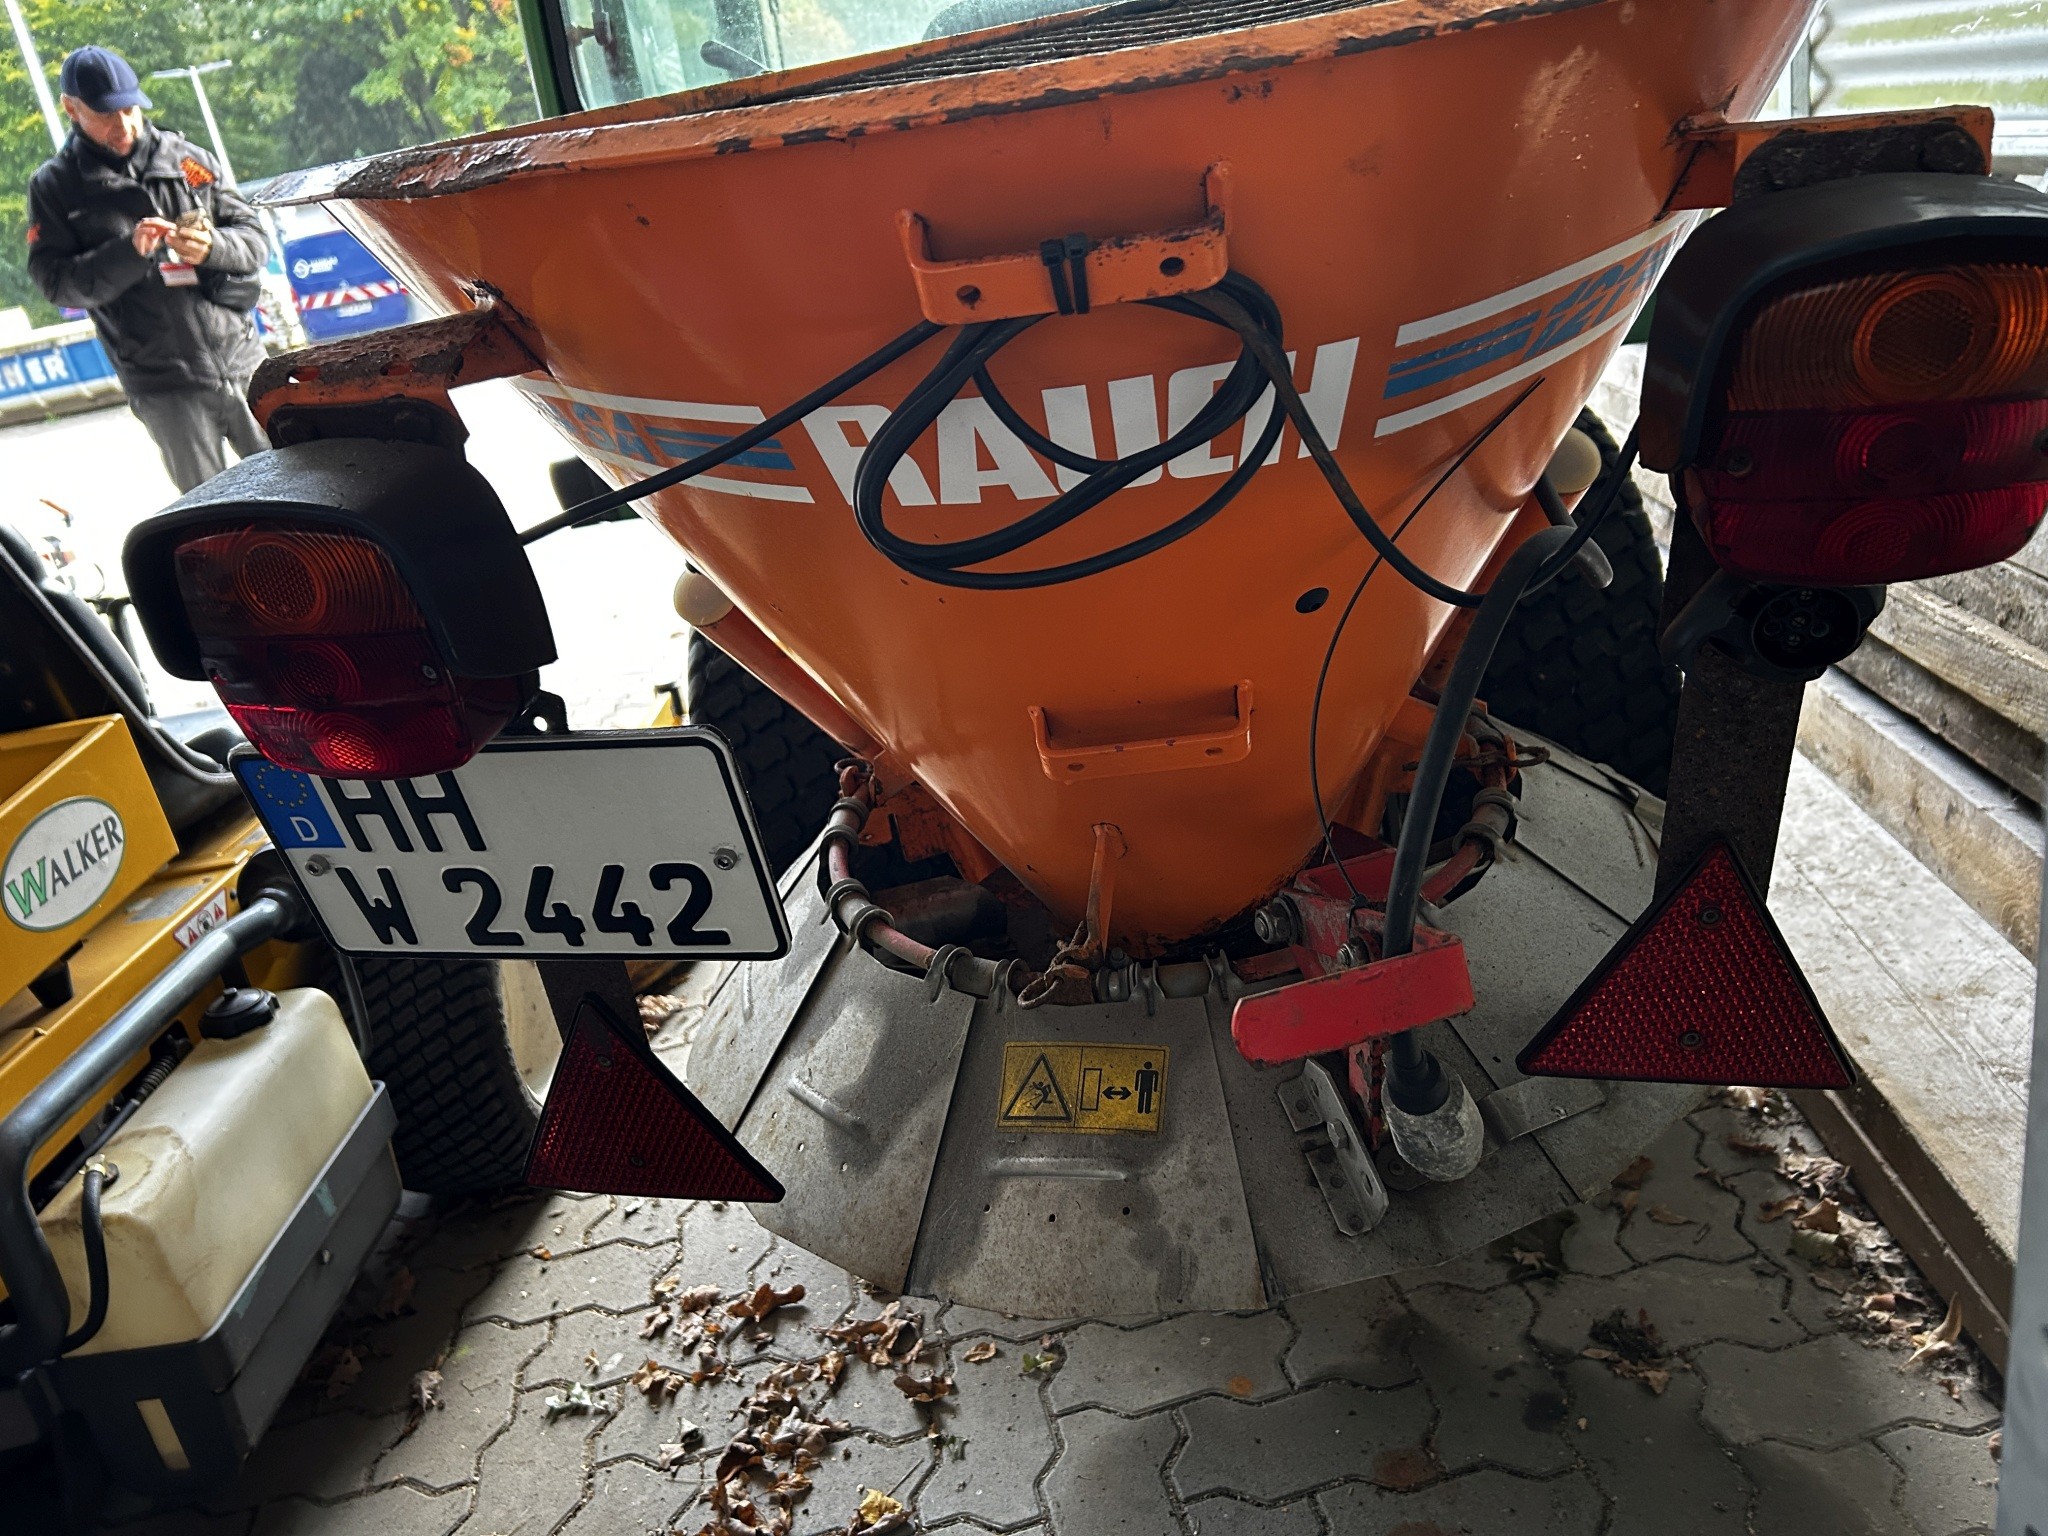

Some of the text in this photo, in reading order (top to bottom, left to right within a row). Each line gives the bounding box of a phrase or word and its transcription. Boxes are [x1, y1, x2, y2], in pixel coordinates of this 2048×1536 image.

[0, 353, 69, 391] NER
[800, 337, 1360, 507] RAUCH
[289, 815, 319, 842] D
[321, 775, 488, 853] HH
[5, 815, 123, 919] WALKER
[335, 862, 732, 947] W 2442
